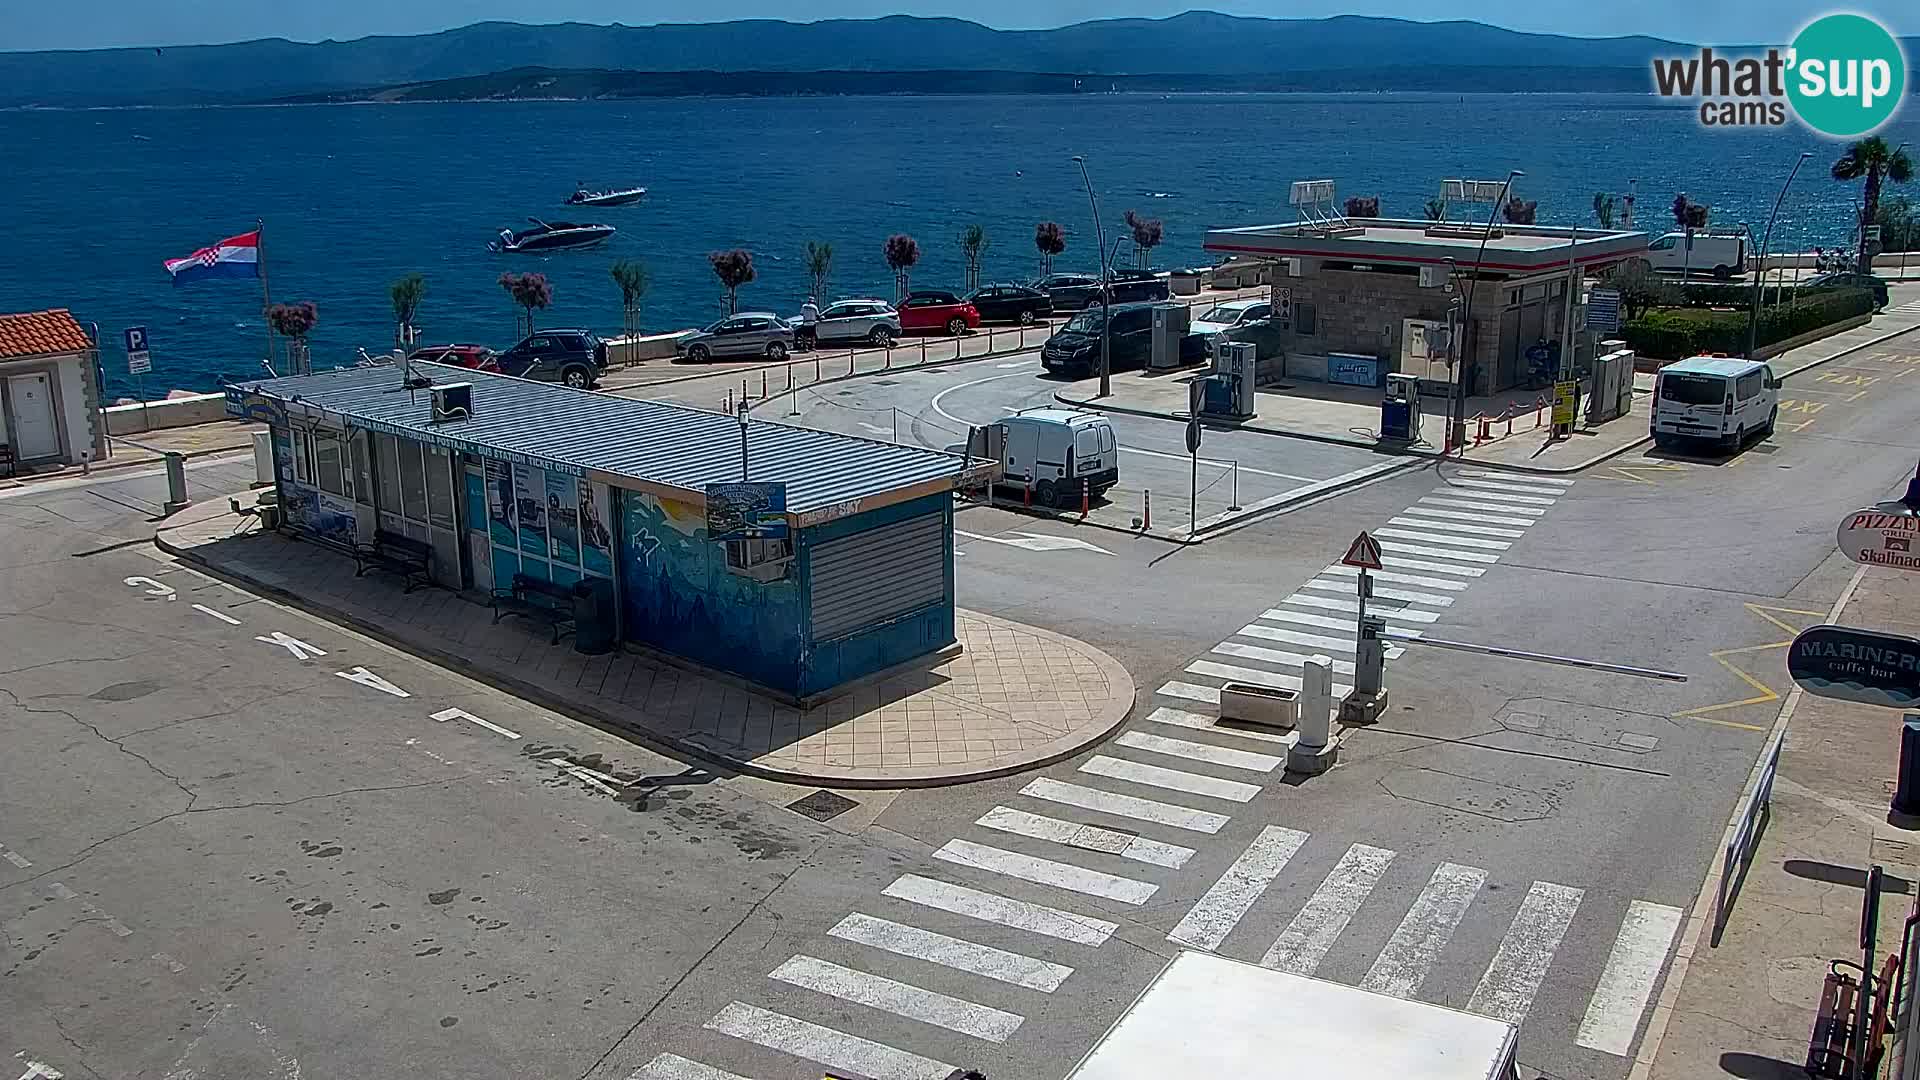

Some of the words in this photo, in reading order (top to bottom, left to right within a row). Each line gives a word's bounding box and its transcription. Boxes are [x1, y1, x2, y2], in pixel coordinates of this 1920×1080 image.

[395, 426, 435, 445] AUTOBUSNA
[436, 436, 467, 451] POSTAJA
[478, 447, 492, 457] BUS
[494, 449, 526, 464] STATION
[527, 456, 554, 471] TICKET
[555, 463, 582, 477] OFFICE
[1881, 529, 1916, 539] GRILL
[1800, 641, 1920, 672] MARINER
[1870, 665, 1896, 679] bar
